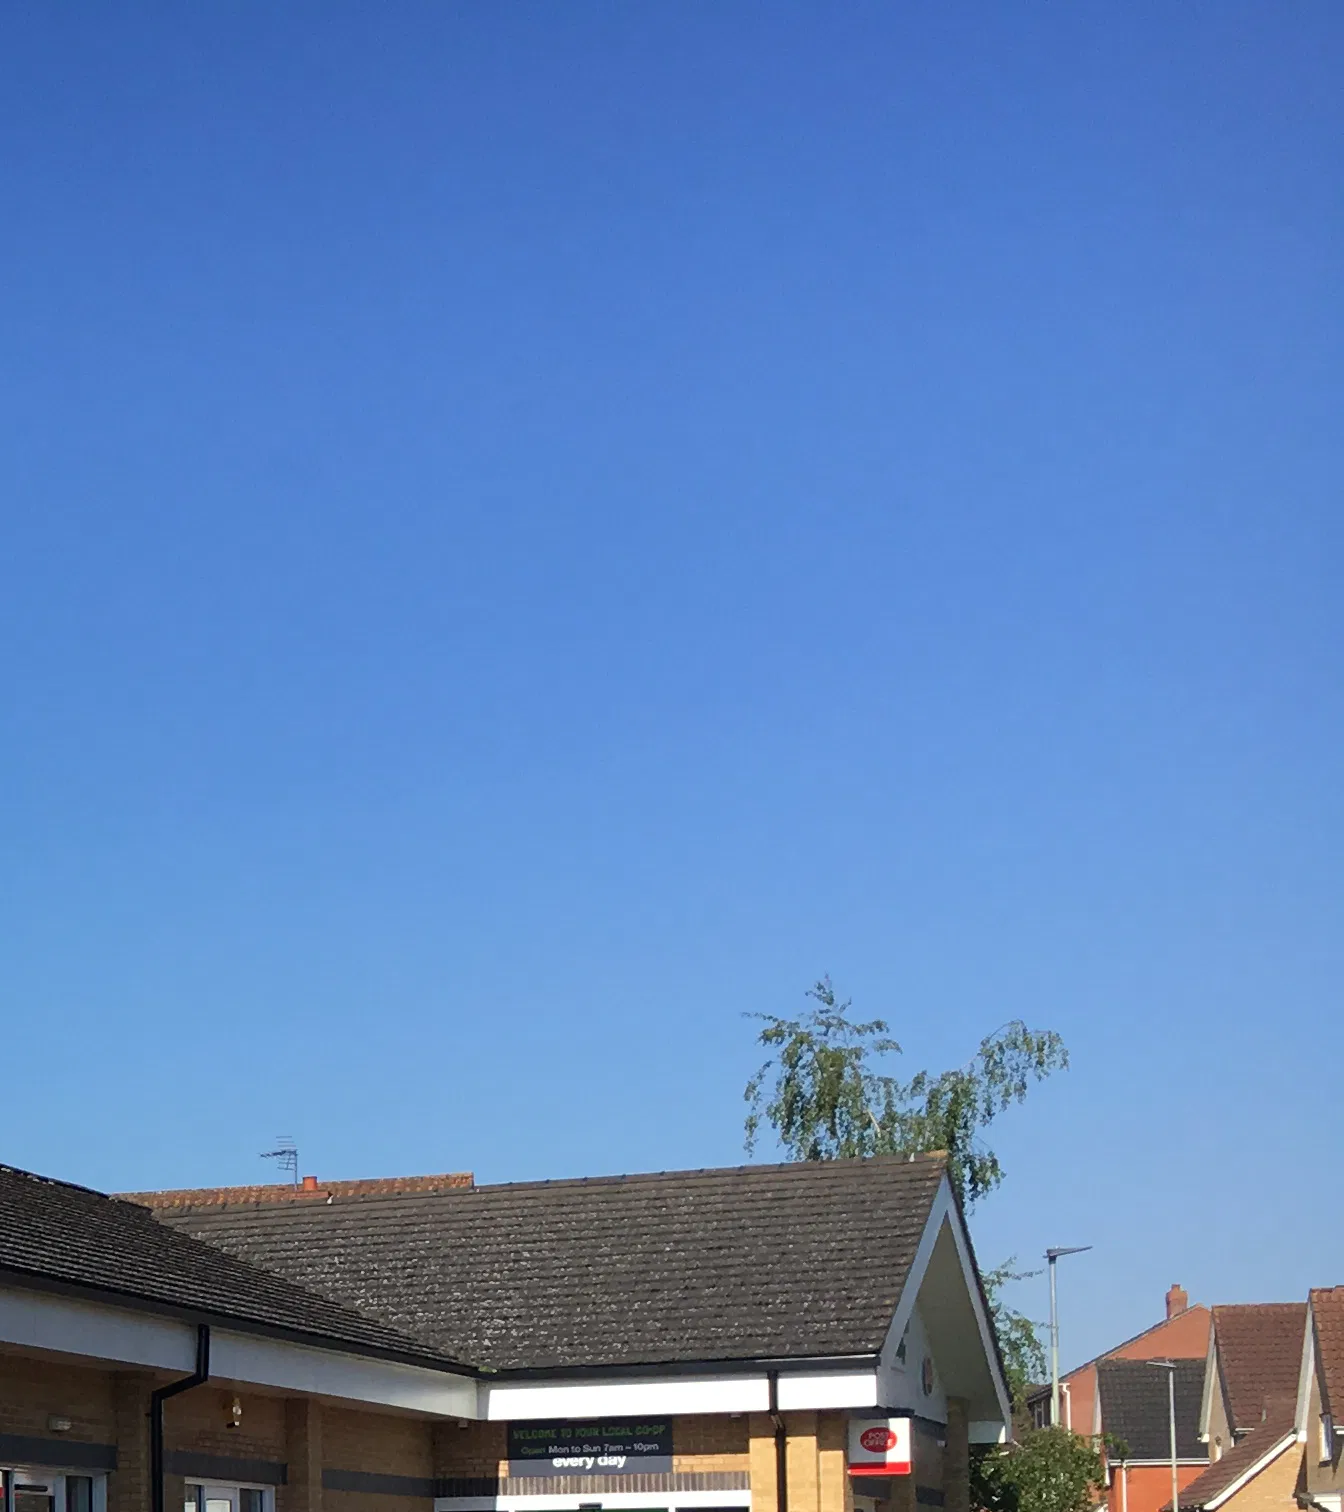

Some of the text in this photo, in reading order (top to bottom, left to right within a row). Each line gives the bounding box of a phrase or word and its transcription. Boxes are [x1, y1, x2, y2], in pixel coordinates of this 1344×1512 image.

[868, 1432, 889, 1440] POST
[548, 1445, 570, 1454] Mon
[571, 1445, 582, 1454] to
[582, 1444, 602, 1453] Sun
[604, 1443, 624, 1452] 7am
[633, 1442, 659, 1453] 10pm
[552, 1453, 627, 1469] every day
